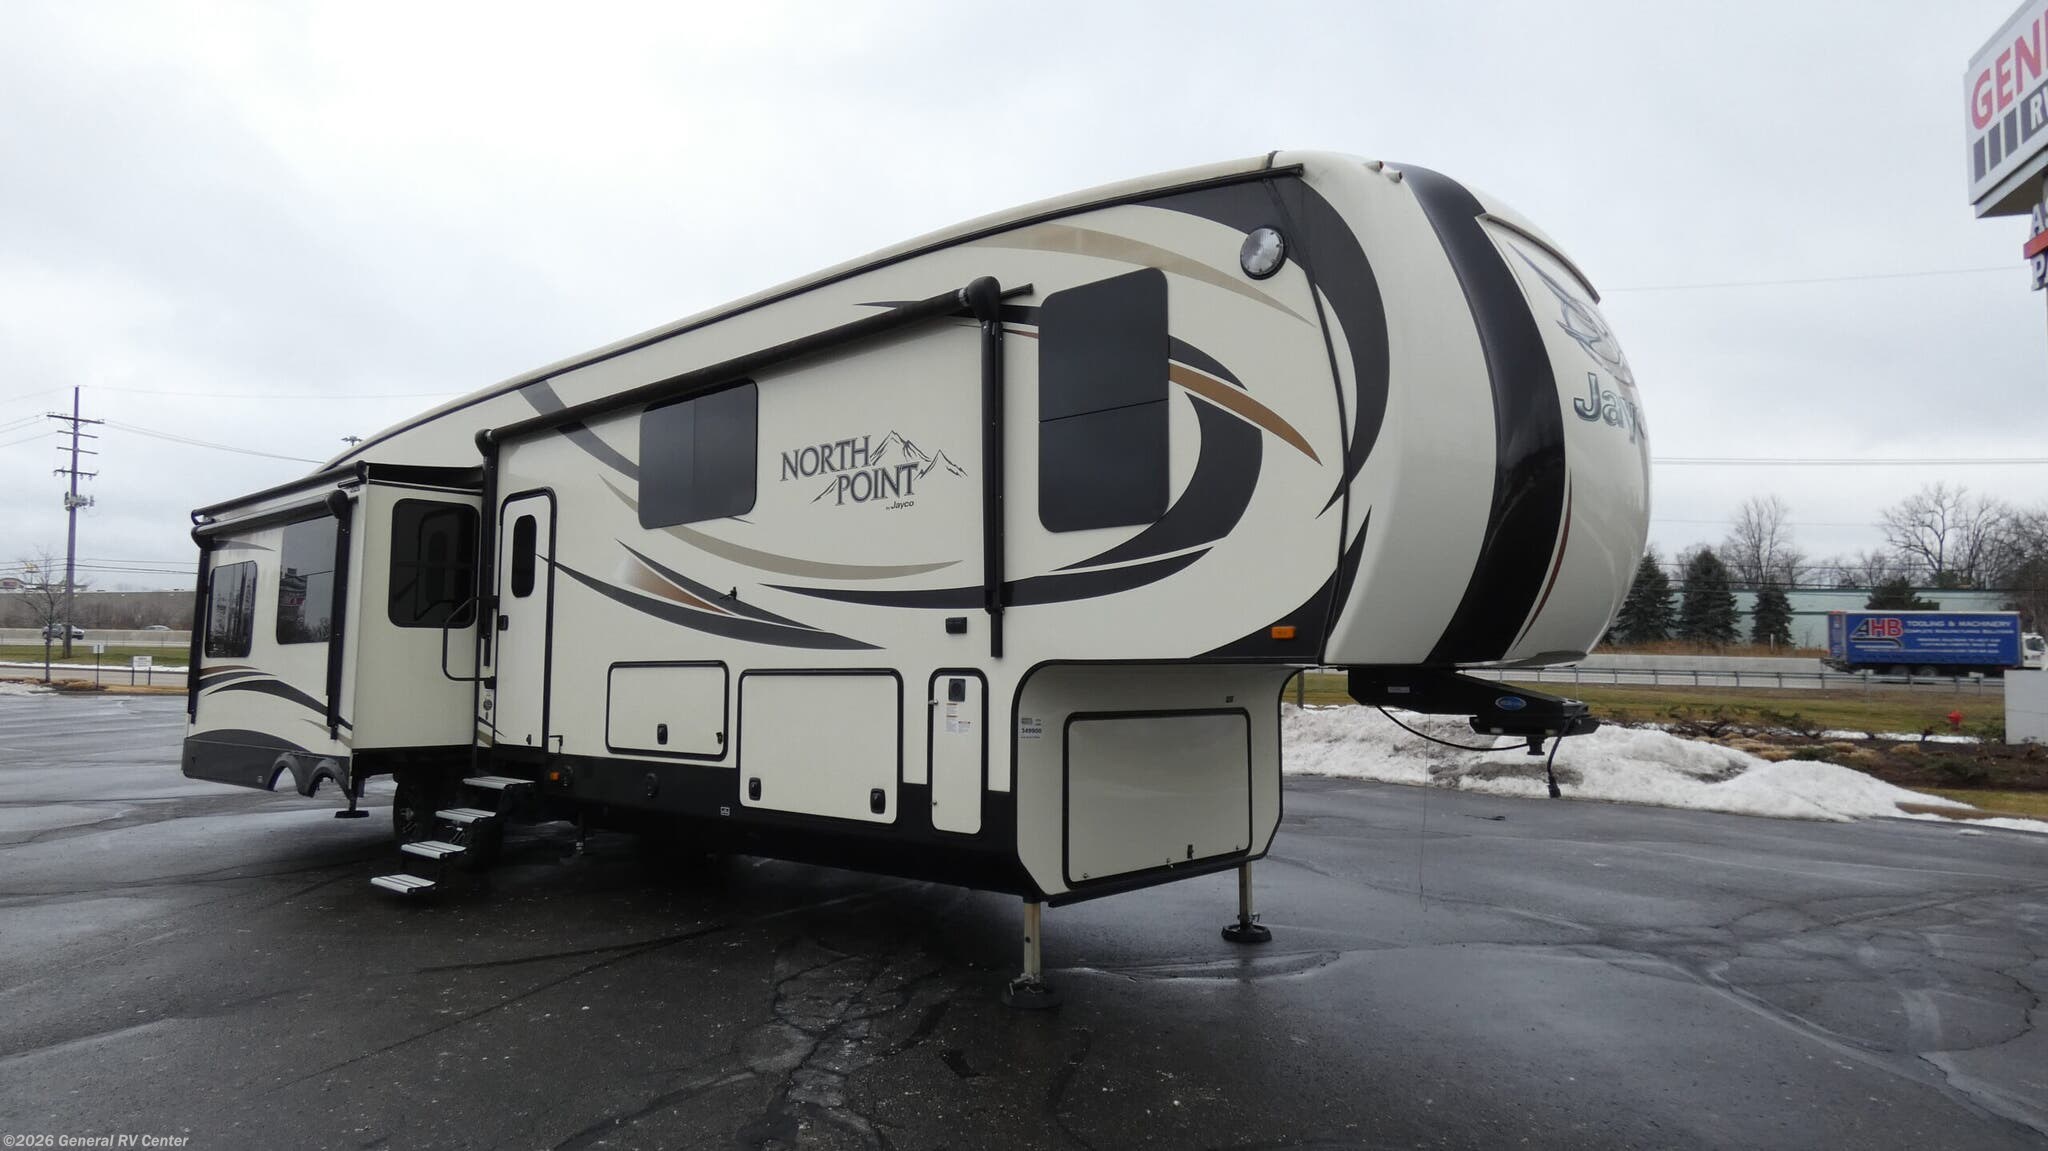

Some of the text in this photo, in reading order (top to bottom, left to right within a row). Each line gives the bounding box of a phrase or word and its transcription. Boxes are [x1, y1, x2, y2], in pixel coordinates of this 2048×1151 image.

[779, 435, 872, 481] NORTH
[835, 461, 919, 506] POINT
[890, 500, 915, 510] Jayco
[1851, 618, 1903, 638] AHB
